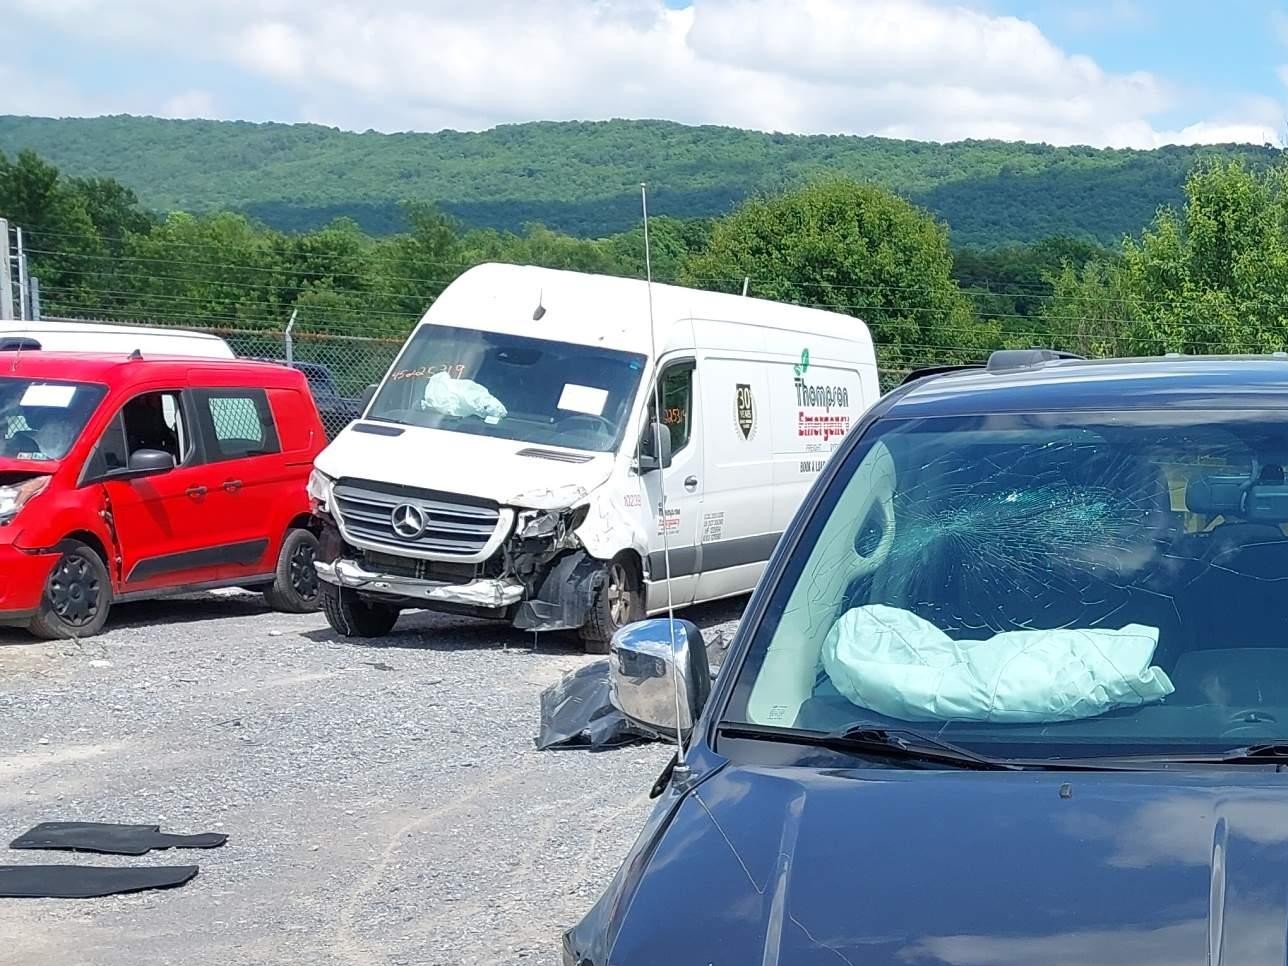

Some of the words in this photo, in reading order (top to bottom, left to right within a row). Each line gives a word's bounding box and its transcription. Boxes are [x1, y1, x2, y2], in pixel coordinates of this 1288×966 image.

[736, 388, 751, 410] 30
[794, 378, 849, 413] Thompson
[799, 412, 850, 441] Emergency
